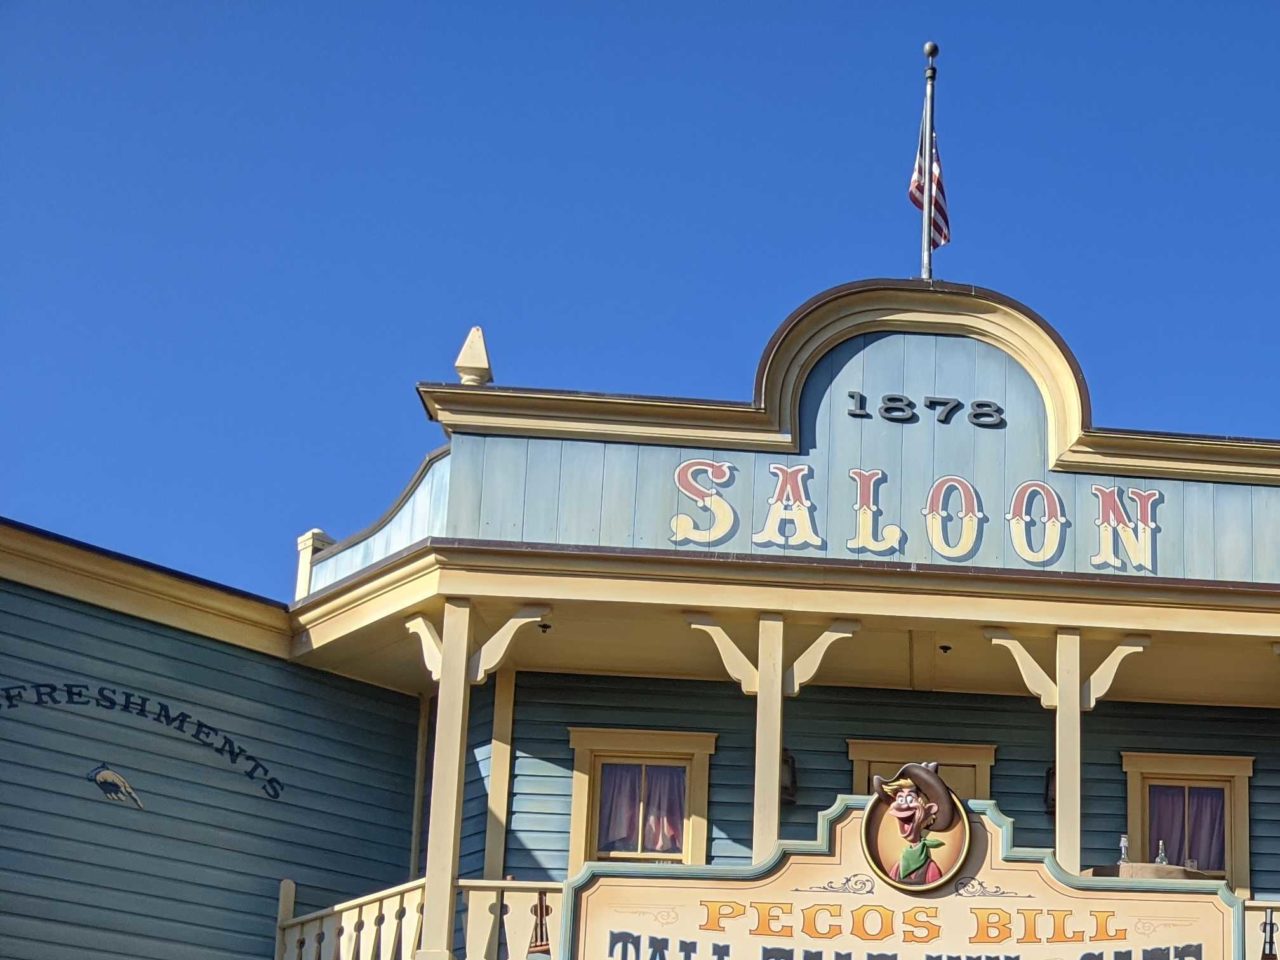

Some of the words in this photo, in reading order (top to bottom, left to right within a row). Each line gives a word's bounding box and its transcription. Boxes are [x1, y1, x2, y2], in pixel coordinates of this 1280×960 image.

[846, 390, 1007, 428] 1878
[669, 458, 1164, 573] SALOON
[0, 683, 285, 800] FRESHMENTS
[698, 899, 942, 944] PECOS
[968, 906, 1128, 945] BILL
